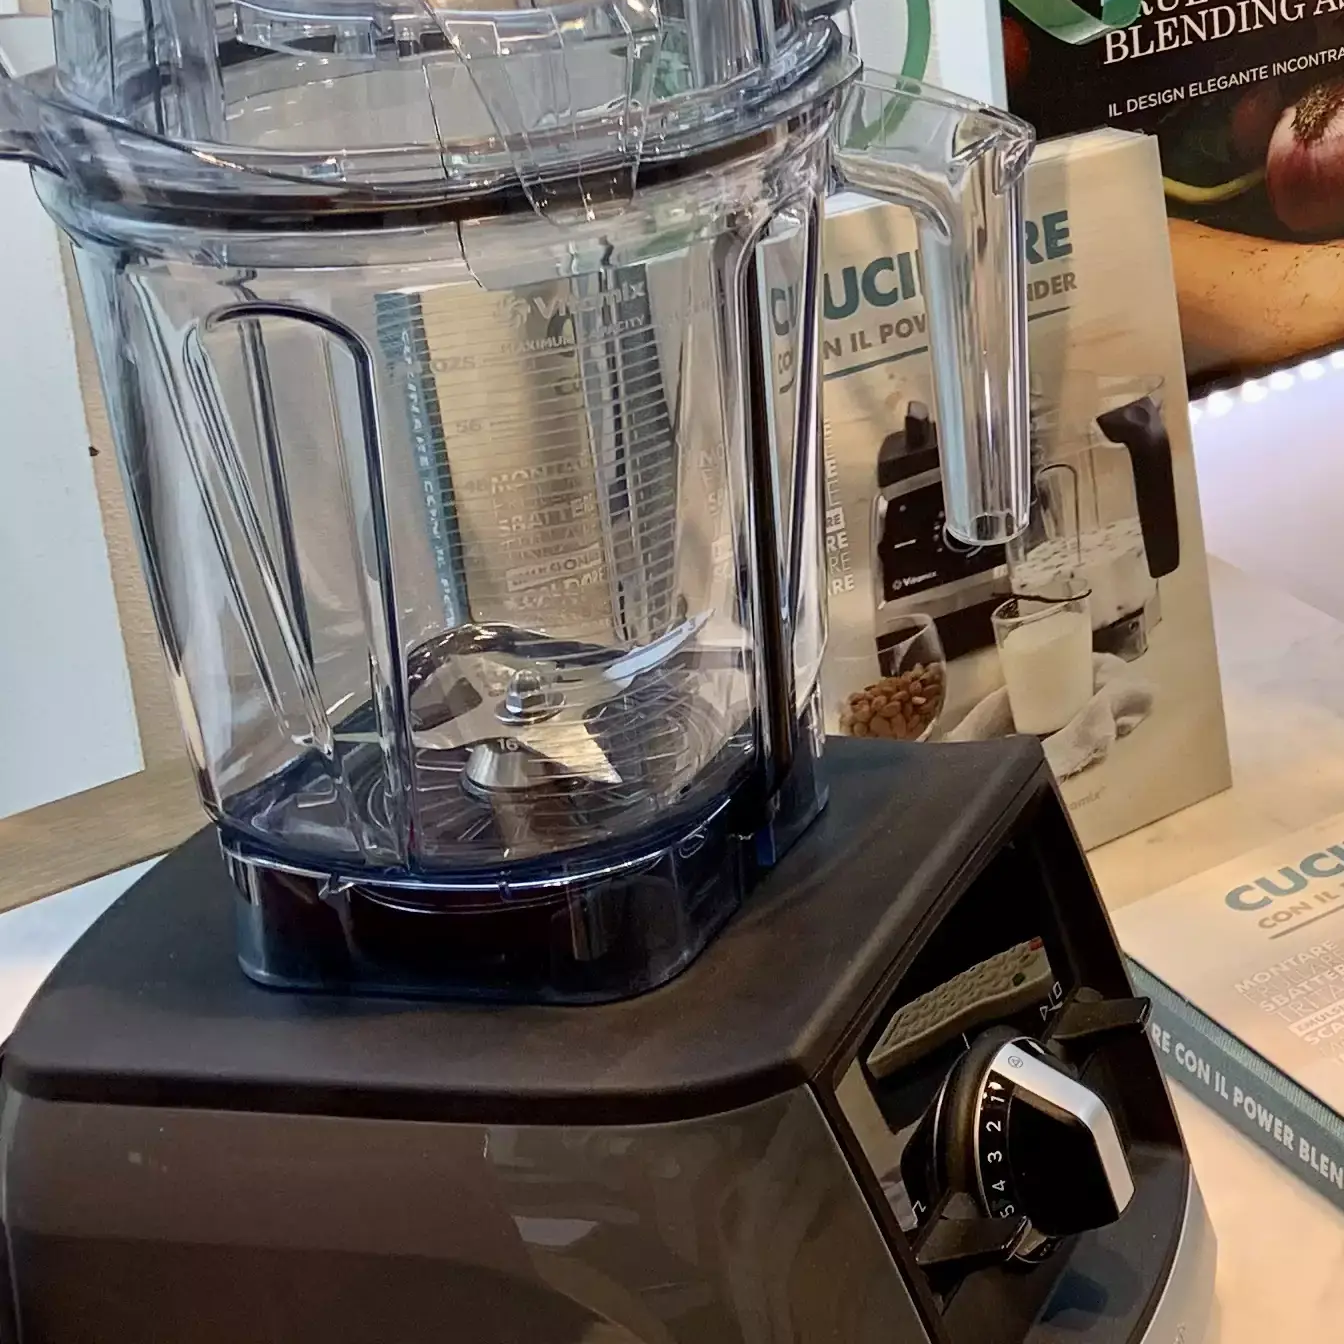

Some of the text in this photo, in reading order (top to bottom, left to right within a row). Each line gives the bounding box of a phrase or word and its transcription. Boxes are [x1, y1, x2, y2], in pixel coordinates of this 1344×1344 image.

[1107, 101, 1125, 118] IL
[1126, 85, 1186, 114] DESIGN
[1187, 64, 1269, 99] ELEGANTE
[851, 331, 872, 353] IL
[498, 738, 519, 751] 16
[1257, 900, 1308, 930] CON
[1313, 889, 1340, 904] IL
[1234, 940, 1338, 994] MONTARE
[1175, 1042, 1212, 1085] CON
[1214, 1071, 1229, 1100] IL
[1233, 1086, 1295, 1151] POWER
[986, 1120, 1002, 1132] 2
[987, 1151, 1002, 1163] 3
[992, 1179, 1006, 1192] 4
[1000, 1204, 1015, 1218] 5
